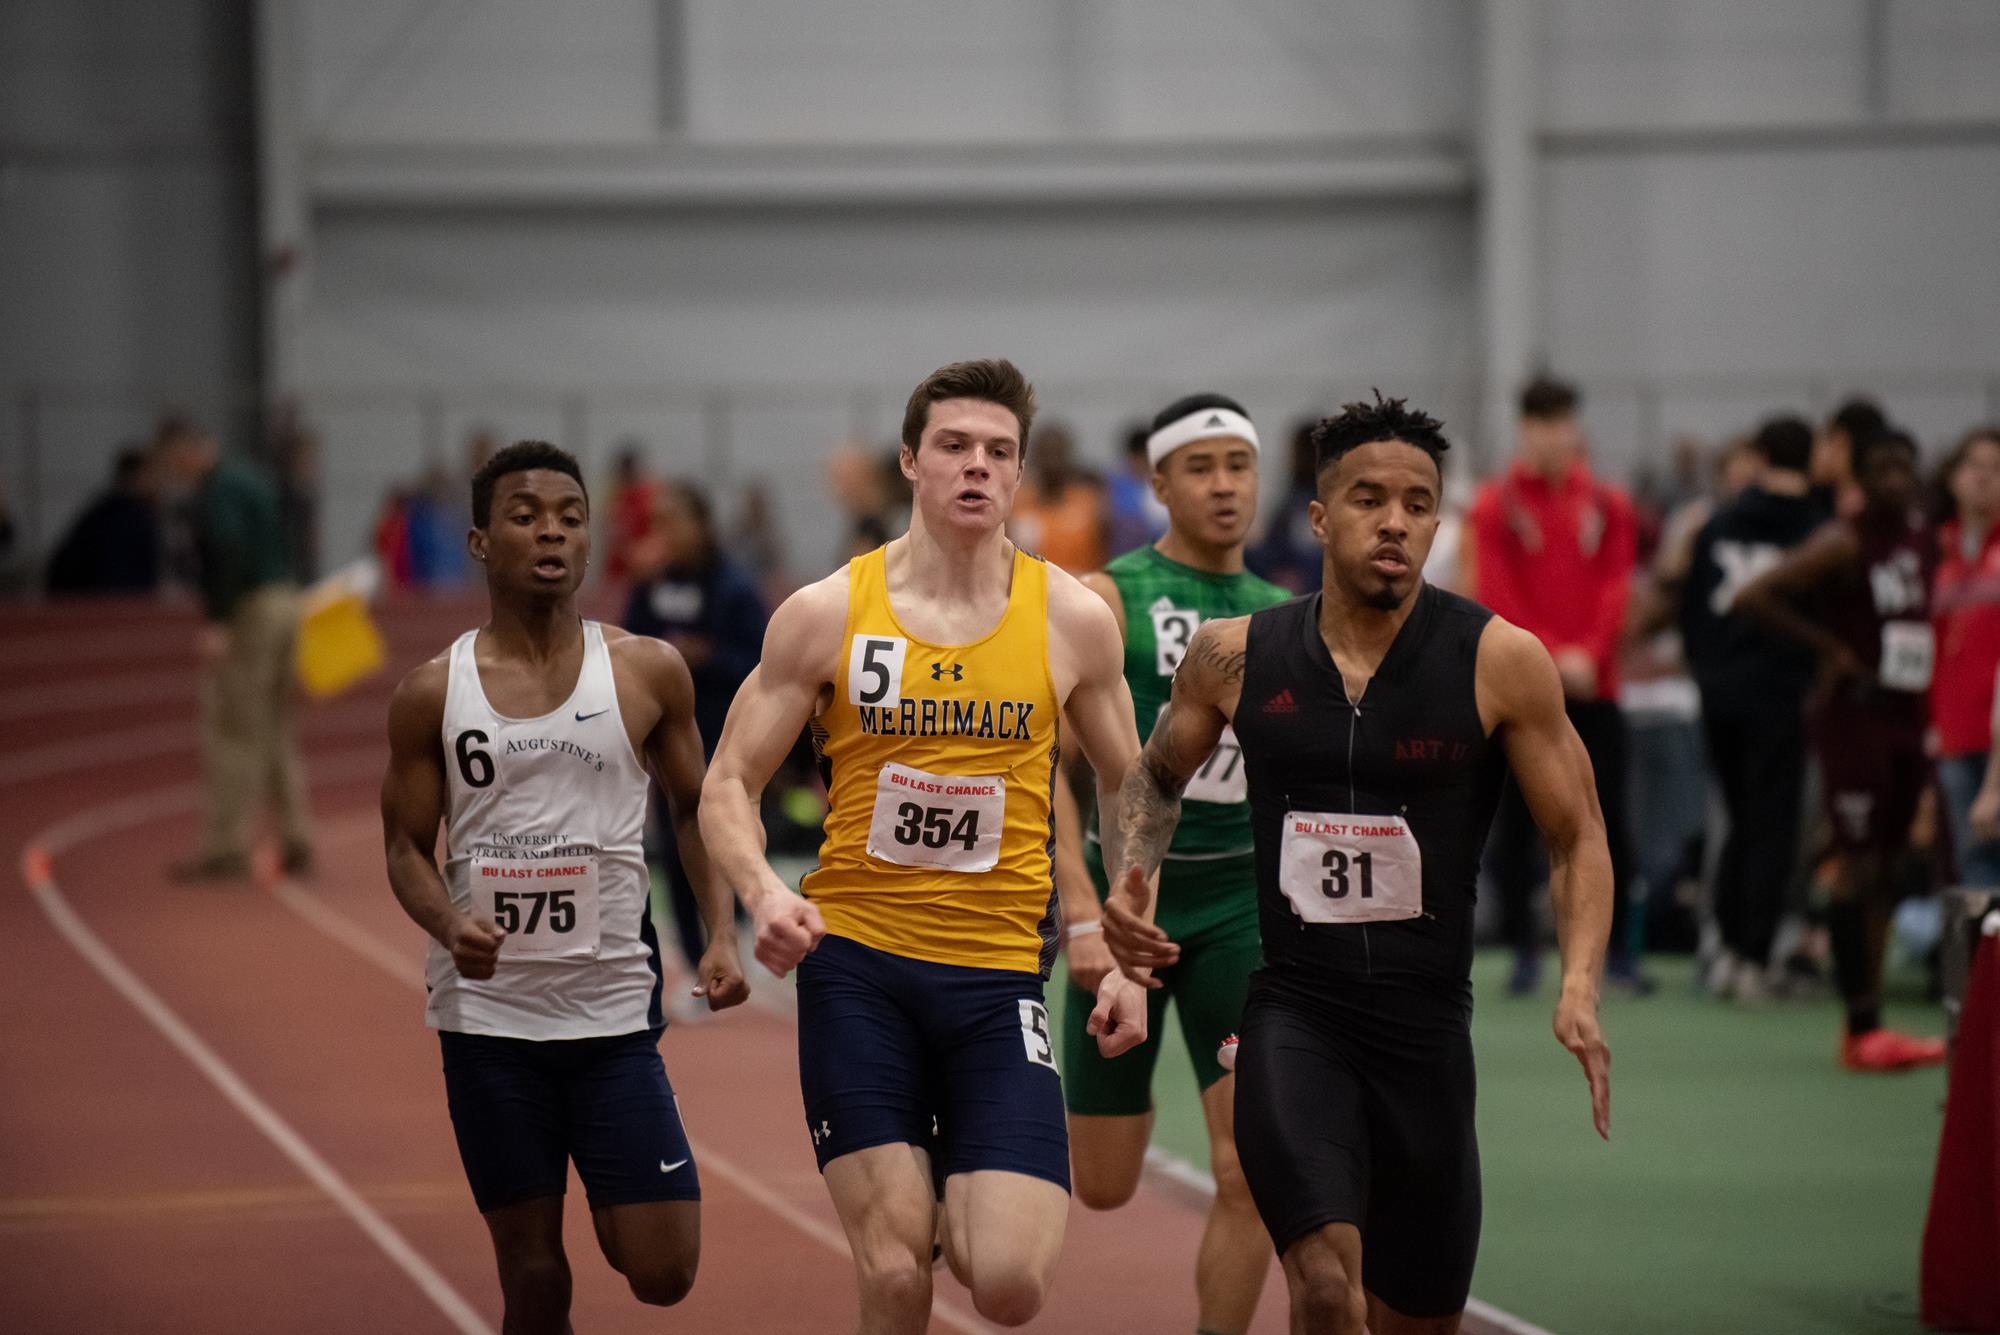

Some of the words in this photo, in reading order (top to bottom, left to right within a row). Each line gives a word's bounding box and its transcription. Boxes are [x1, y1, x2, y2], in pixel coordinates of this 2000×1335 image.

[1162, 616, 1190, 667] 3
[859, 639, 895, 704] 5
[858, 697, 1035, 741] MERRIMACK
[455, 729, 496, 789] 6
[891, 773, 908, 787] BU
[910, 781, 942, 794] LAST
[946, 785, 996, 796] CHANCE
[894, 801, 980, 851] 354
[1295, 822, 1312, 833] BU
[1315, 824, 1348, 836] LAST
[1352, 826, 1406, 837] CHANCE
[482, 867, 499, 877] BU
[501, 868, 532, 879] LAST
[536, 865, 587, 877] CHANCE
[1322, 849, 1373, 899] 31
[493, 889, 577, 935] 575
[1031, 1005, 1053, 1065] 5
